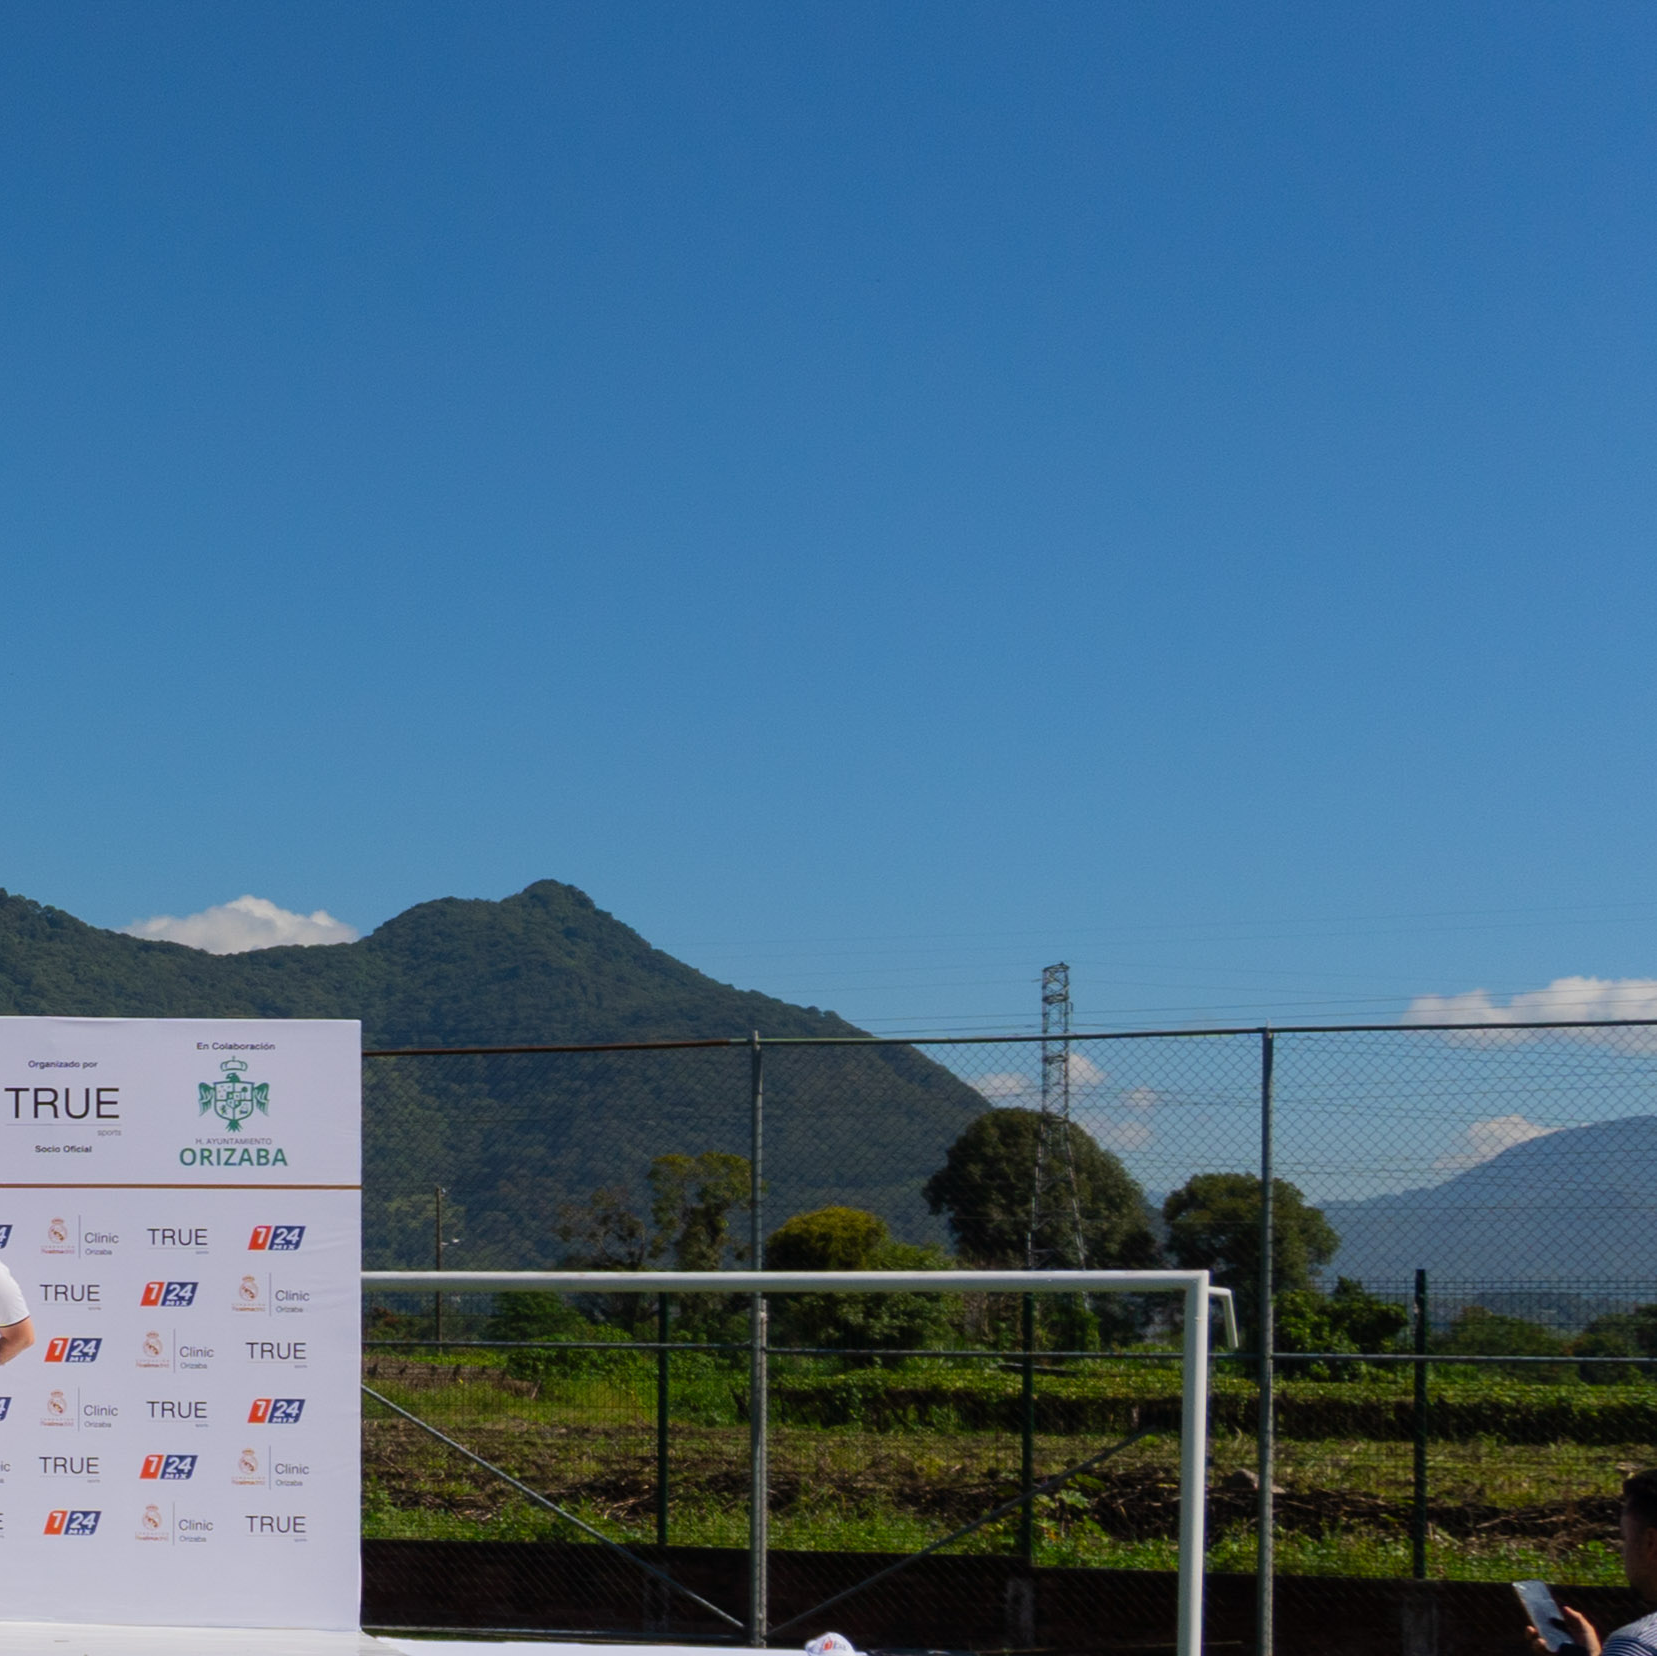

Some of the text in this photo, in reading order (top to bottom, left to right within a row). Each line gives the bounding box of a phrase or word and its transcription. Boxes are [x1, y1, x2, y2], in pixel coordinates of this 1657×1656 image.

[197, 1042, 275, 1050] En Colaboración
[28, 1060, 80, 1069] Organizado
[4, 1088, 119, 1119] TRUE
[35, 1145, 92, 1153] Socio Oficial
[180, 1148, 288, 1166] ORIZABA
[84, 1232, 119, 1244] Clinic
[147, 1228, 207, 1246] TRUE
[39, 1284, 100, 1302] TRUE
[275, 1290, 310, 1301] Clinic
[179, 1346, 214, 1358] Clinic
[245, 1342, 306, 1360] TRUE
[84, 1405, 118, 1416] Clinic
[146, 1401, 207, 1418] TRUE
[39, 1457, 99, 1474] TRUE
[178, 1519, 213, 1531] Clinic
[245, 1516, 306, 1533] TRUE
